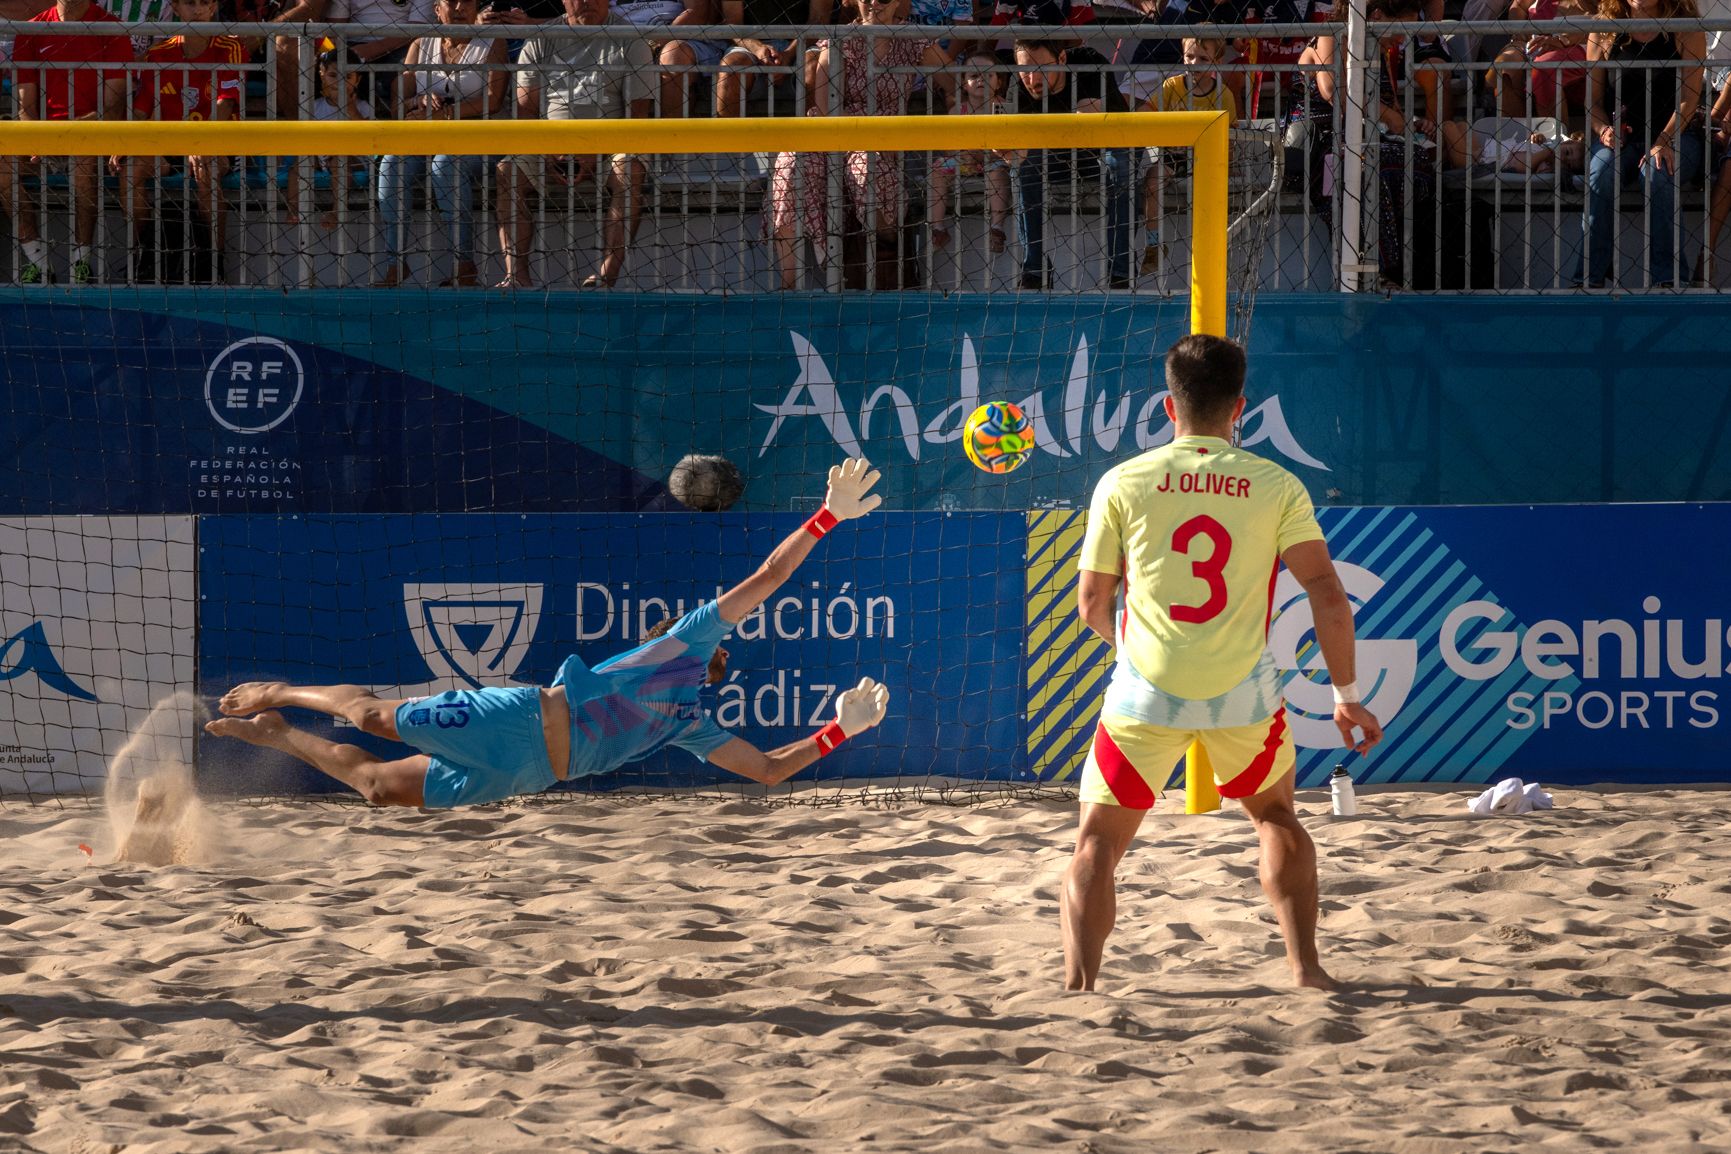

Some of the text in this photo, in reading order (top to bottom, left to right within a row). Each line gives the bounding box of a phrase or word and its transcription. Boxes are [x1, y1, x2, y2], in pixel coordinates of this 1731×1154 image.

[230, 361, 283, 380] RF
[226, 388, 280, 408] EF
[227, 446, 269, 455] REAL
[190, 458, 301, 469] FEDERACIÓN
[200, 474, 292, 484] ESPAÑOLA
[1157, 473, 1251, 498] J. OLIVER
[197, 489, 219, 498] DE
[1169, 514, 1232, 625] 3
[1439, 596, 1731, 681] Geniu
[704, 669, 837, 727] ádiz
[1506, 690, 1719, 730] SPORTS
